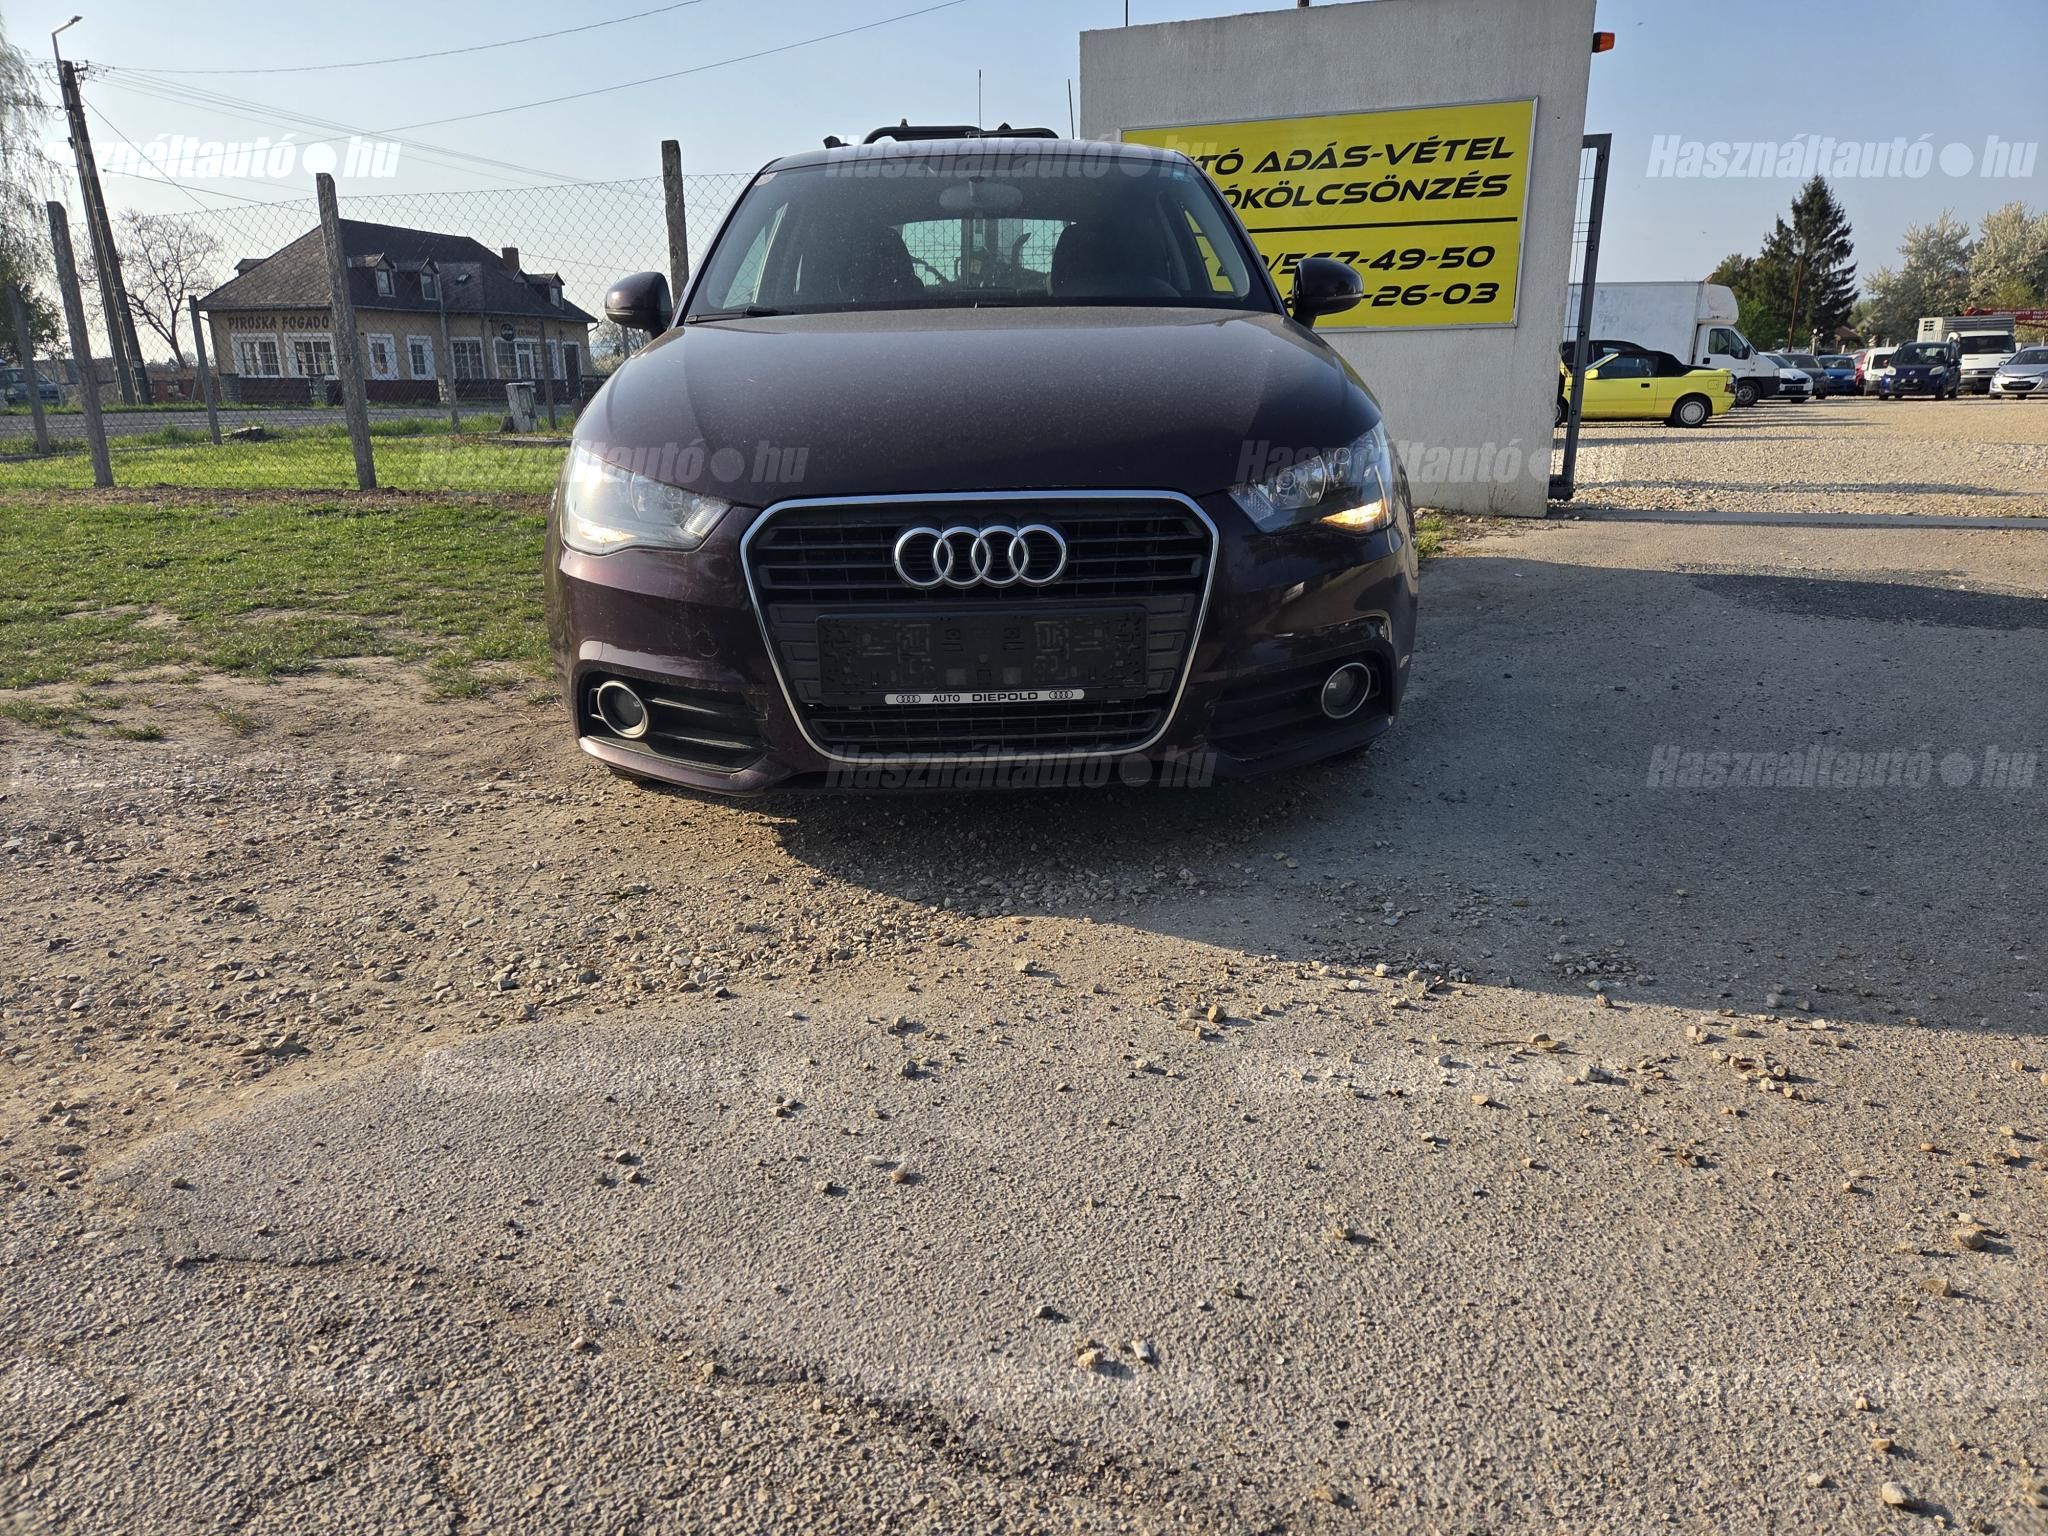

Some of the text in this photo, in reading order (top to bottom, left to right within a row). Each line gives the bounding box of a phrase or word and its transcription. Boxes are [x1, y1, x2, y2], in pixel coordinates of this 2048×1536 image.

[1190, 135, 1514, 175] TÓ ADÁS-VÉTEL
[228, 317, 277, 329] PIROSKA
[932, 692, 1038, 703] AUTO DIEPOLD
